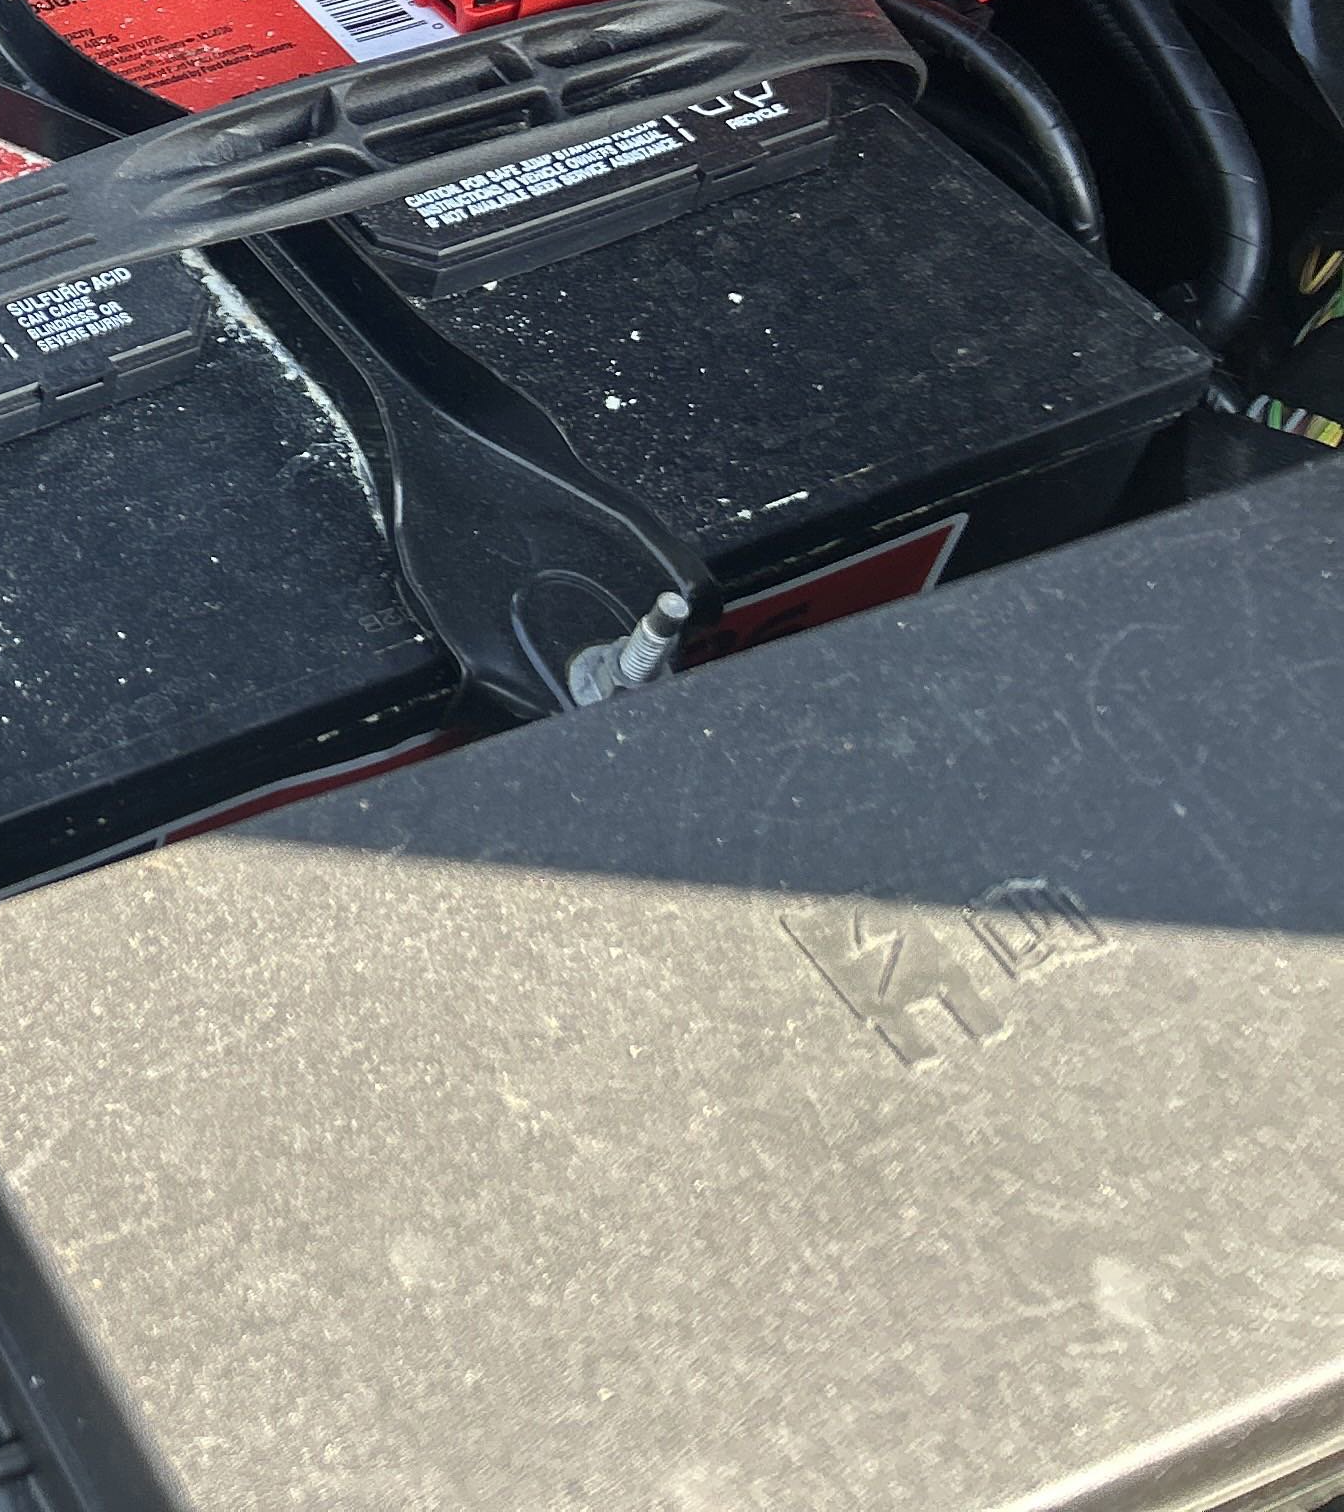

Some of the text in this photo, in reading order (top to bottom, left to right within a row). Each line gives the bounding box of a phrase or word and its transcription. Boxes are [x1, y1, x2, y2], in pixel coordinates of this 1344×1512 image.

[432, 22, 445, 30] 0
[724, 103, 791, 131] RECYCLE
[416, 184, 506, 218] INSTRUCTIONS
[500, 178, 522, 191] IN
[515, 162, 570, 186] VEHICLE
[424, 216, 440, 229] IF
[439, 208, 469, 226] NOT
[467, 189, 532, 216] AVAILABLE
[526, 178, 564, 197] SEEK
[558, 161, 612, 186] SERVICE
[459, 174, 490, 191] FOR
[485, 164, 523, 183] SAFE
[6, 267, 133, 317] SULFURIC ACID
[16, 296, 97, 329] CAN CAUSE
[26, 300, 124, 341] BLINDNESS OR
[35, 312, 135, 354] SEVERE BURNS
